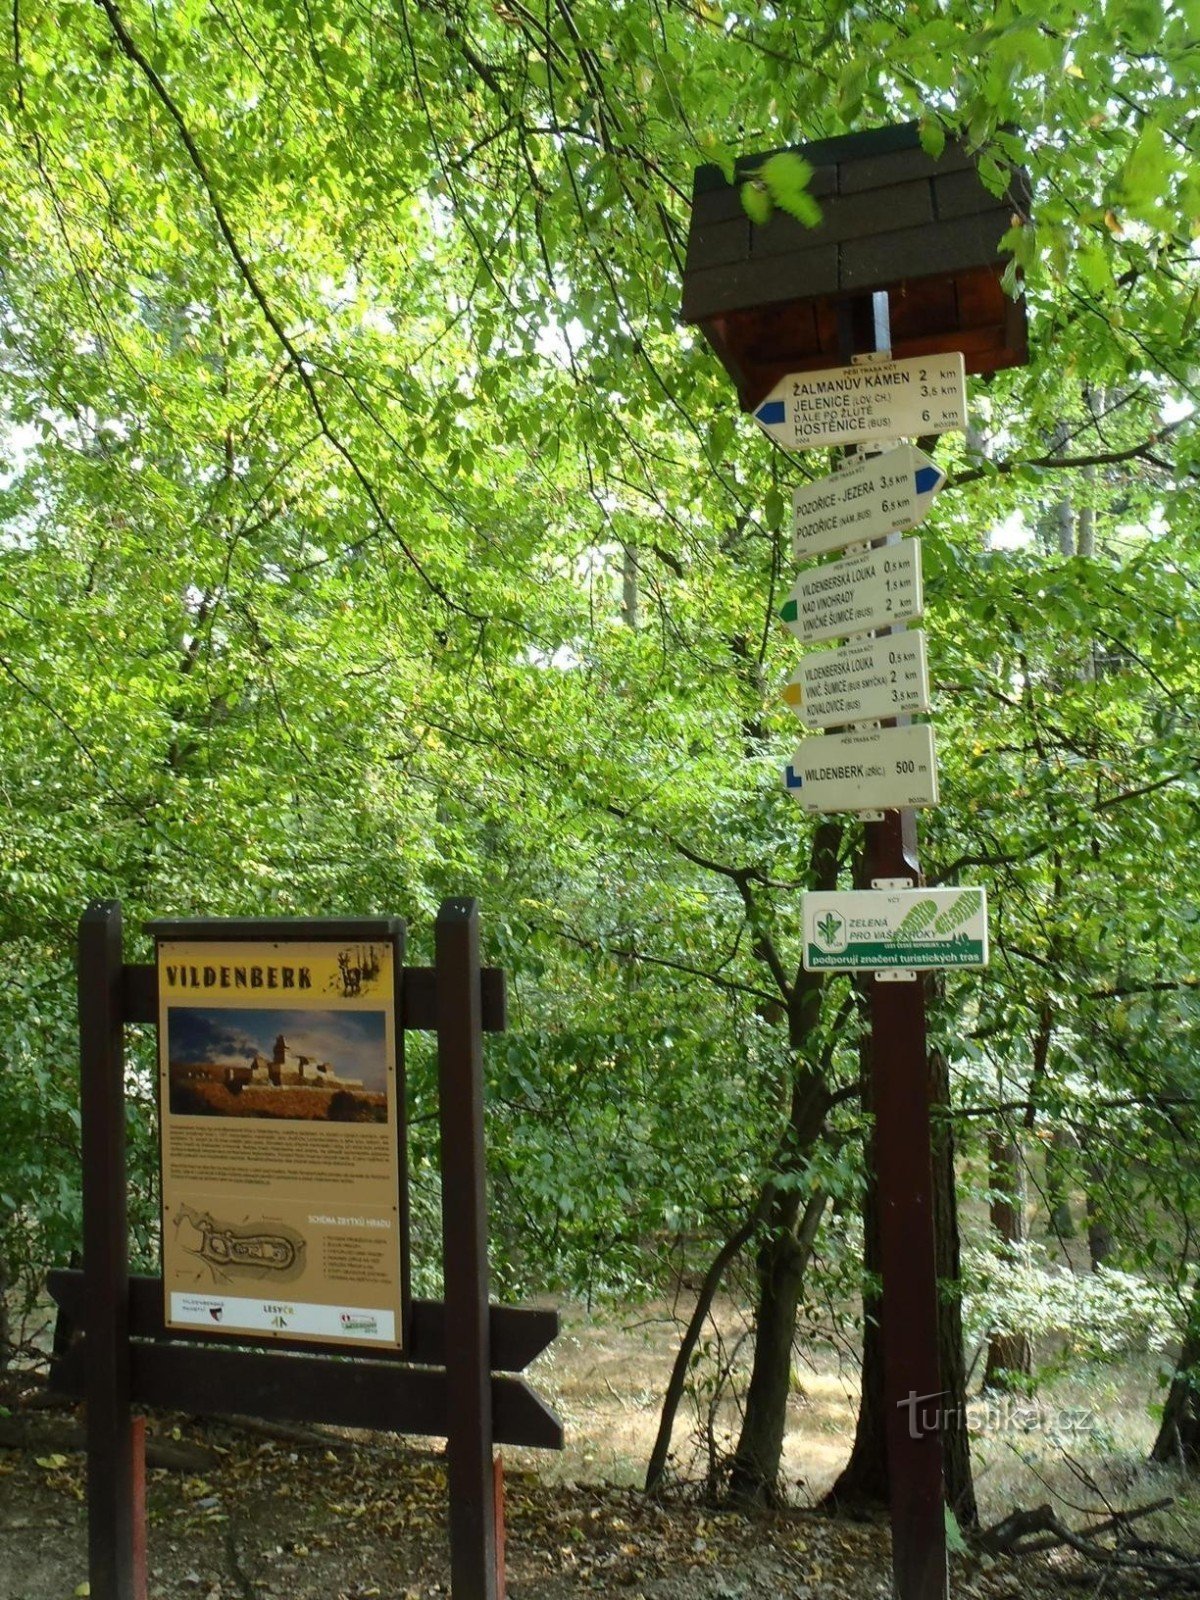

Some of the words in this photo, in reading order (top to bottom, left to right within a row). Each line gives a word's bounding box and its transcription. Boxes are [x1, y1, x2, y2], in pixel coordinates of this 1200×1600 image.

[864, 371, 910, 388] KÁMEN
[919, 369, 927, 381] 2
[940, 370, 956, 379] km
[794, 395, 850, 413] JELENICE
[941, 386, 957, 395] km
[823, 410, 838, 420] PO
[794, 417, 866, 436] HOSTĚNICE
[922, 409, 931, 422] 6
[942, 411, 958, 420] km
[842, 480, 875, 502] JEZERA
[896, 474, 909, 483] km
[897, 498, 910, 508] km
[851, 565, 876, 583] LOUKA
[898, 560, 911, 569] km
[899, 579, 912, 588] km
[885, 598, 892, 612] 2
[900, 599, 912, 608] km
[851, 656, 874, 673] LOUKA
[903, 652, 916, 662] km
[890, 670, 897, 683] 2
[904, 671, 917, 681] km
[906, 690, 919, 700] km
[804, 764, 864, 781] WILDENBERK
[895, 760, 915, 774] 500
[918, 764, 927, 772] m
[848, 916, 888, 928] ZELENÁ
[849, 931, 871, 940] PRO
[899, 952, 957, 965] turistických
[960, 953, 980, 963] tras
[166, 965, 312, 989] VILDENBERK
